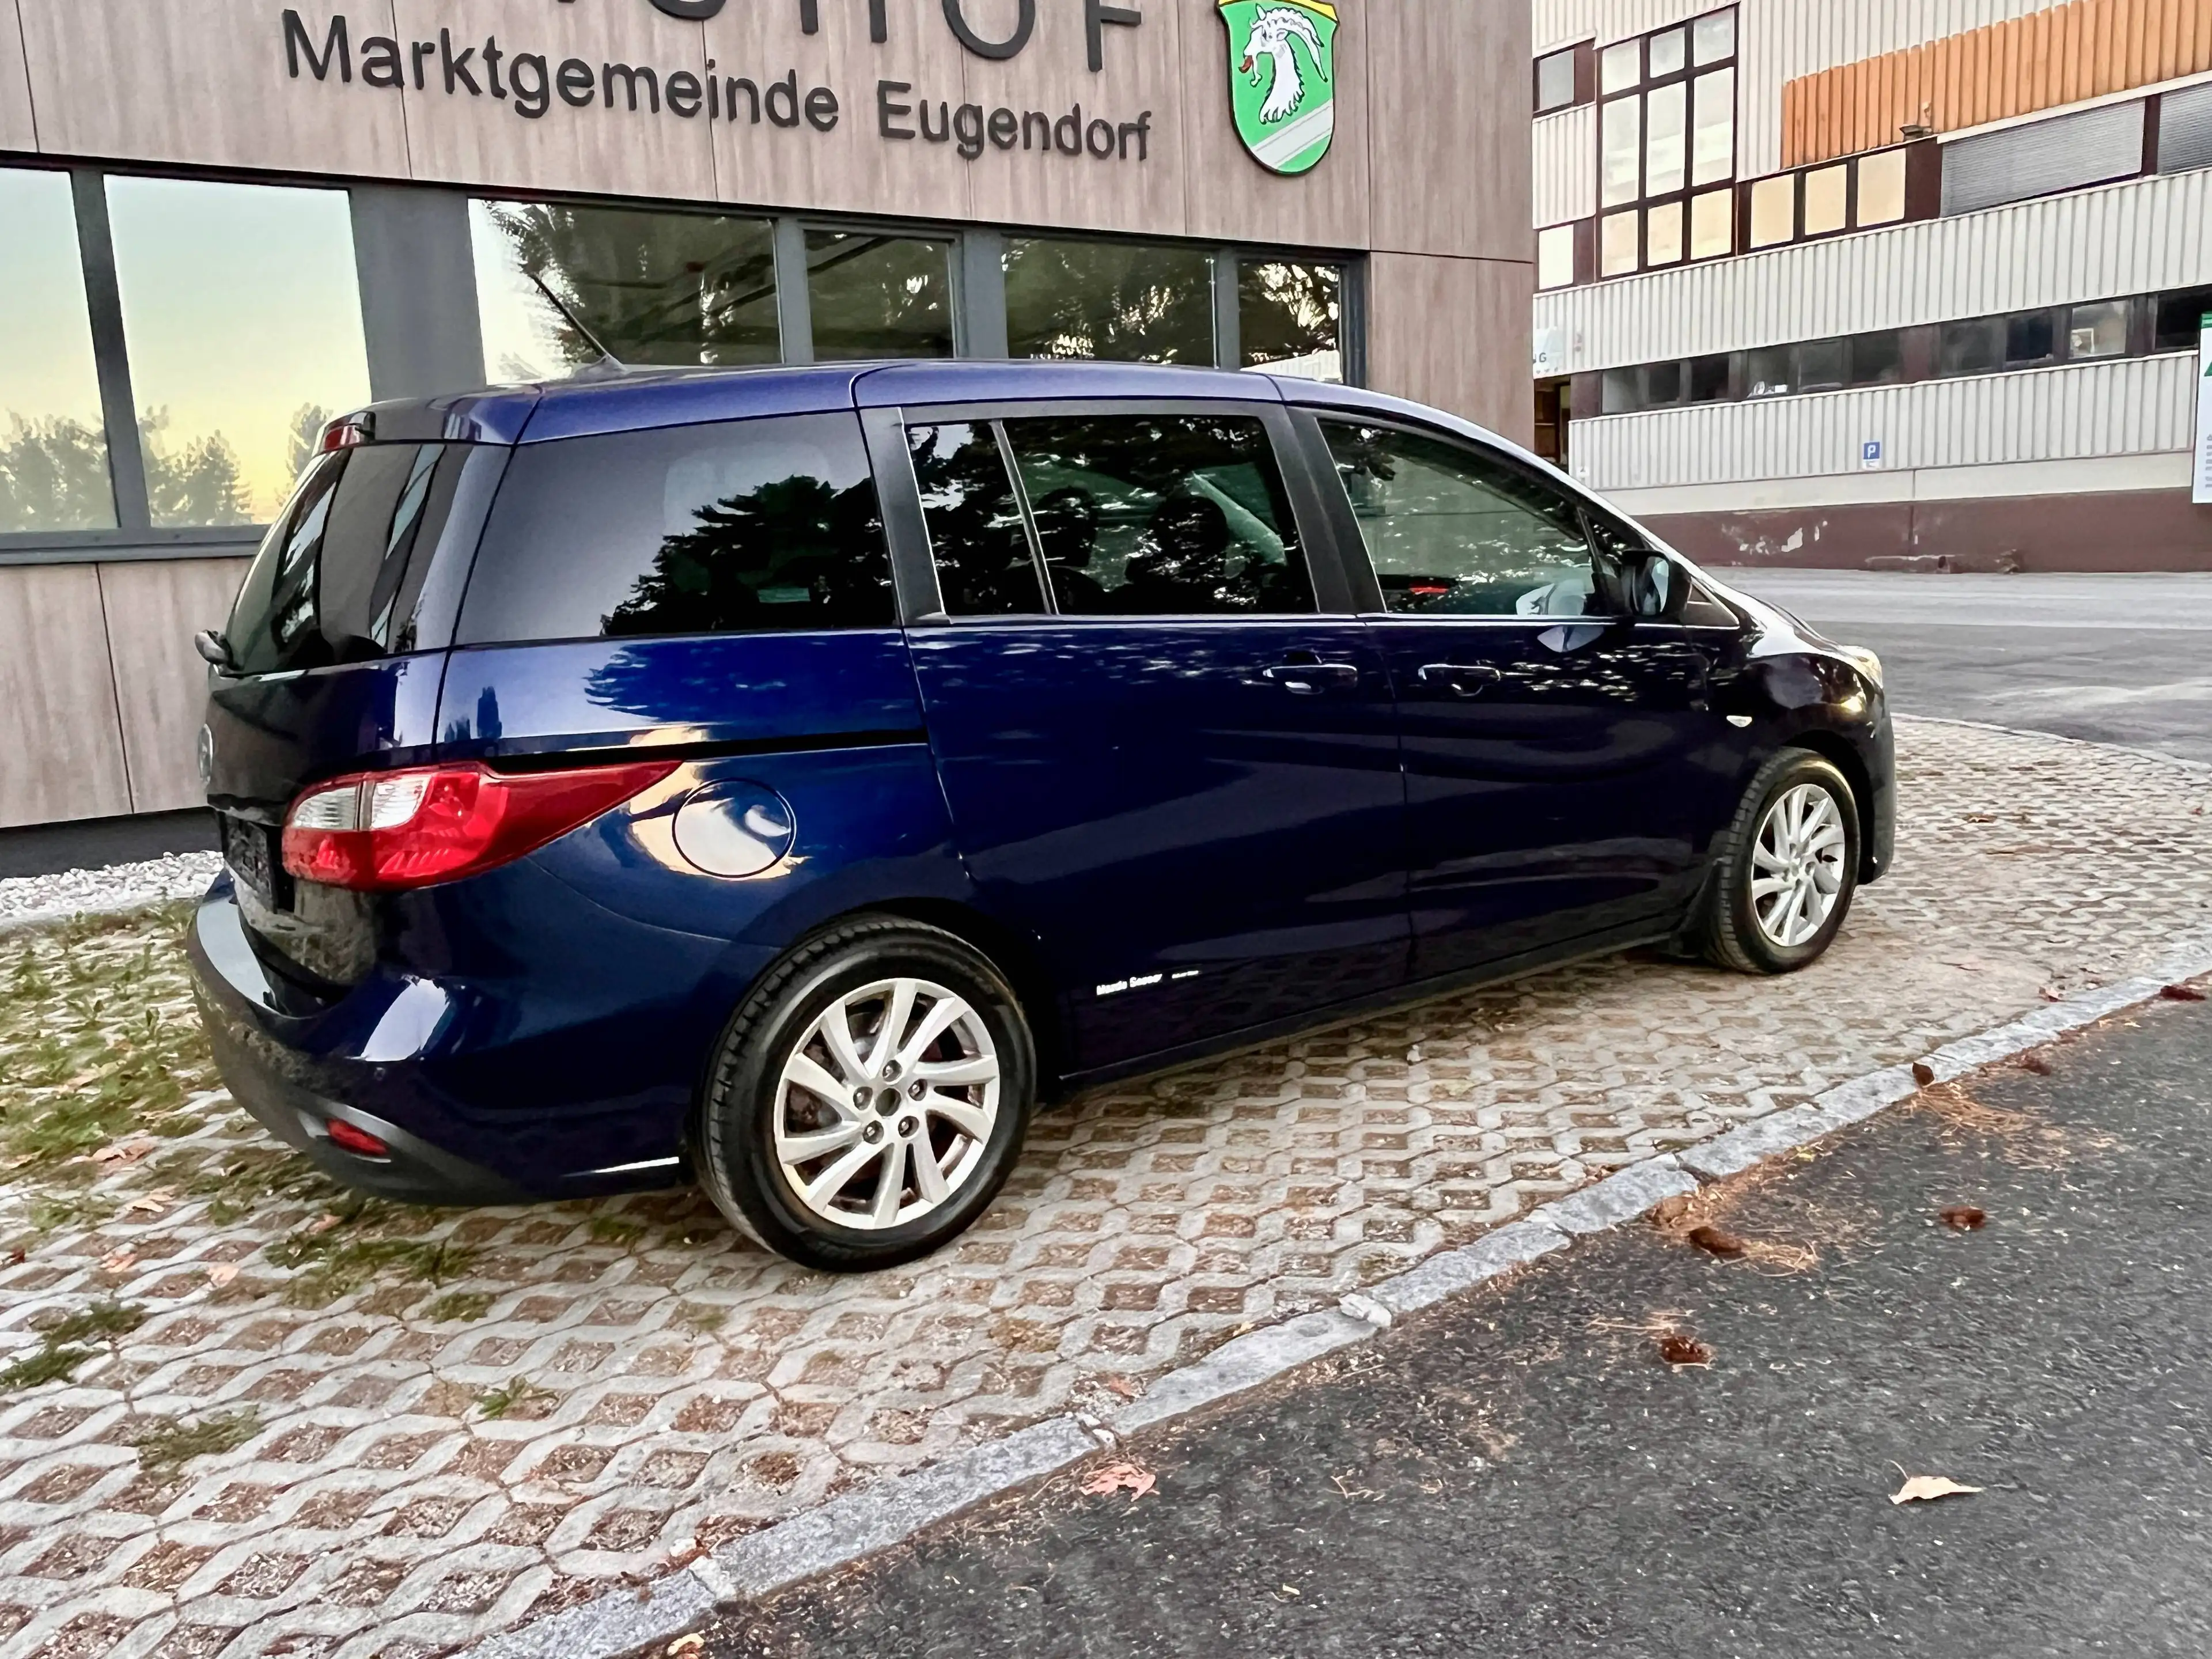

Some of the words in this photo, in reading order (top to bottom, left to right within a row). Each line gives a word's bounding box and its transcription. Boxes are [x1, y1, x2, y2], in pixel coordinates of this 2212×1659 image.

[283, 9, 839, 132] Marktgemeinde
[877, 80, 1152, 163] Eugendorf
[1868, 445, 1876, 459] P
